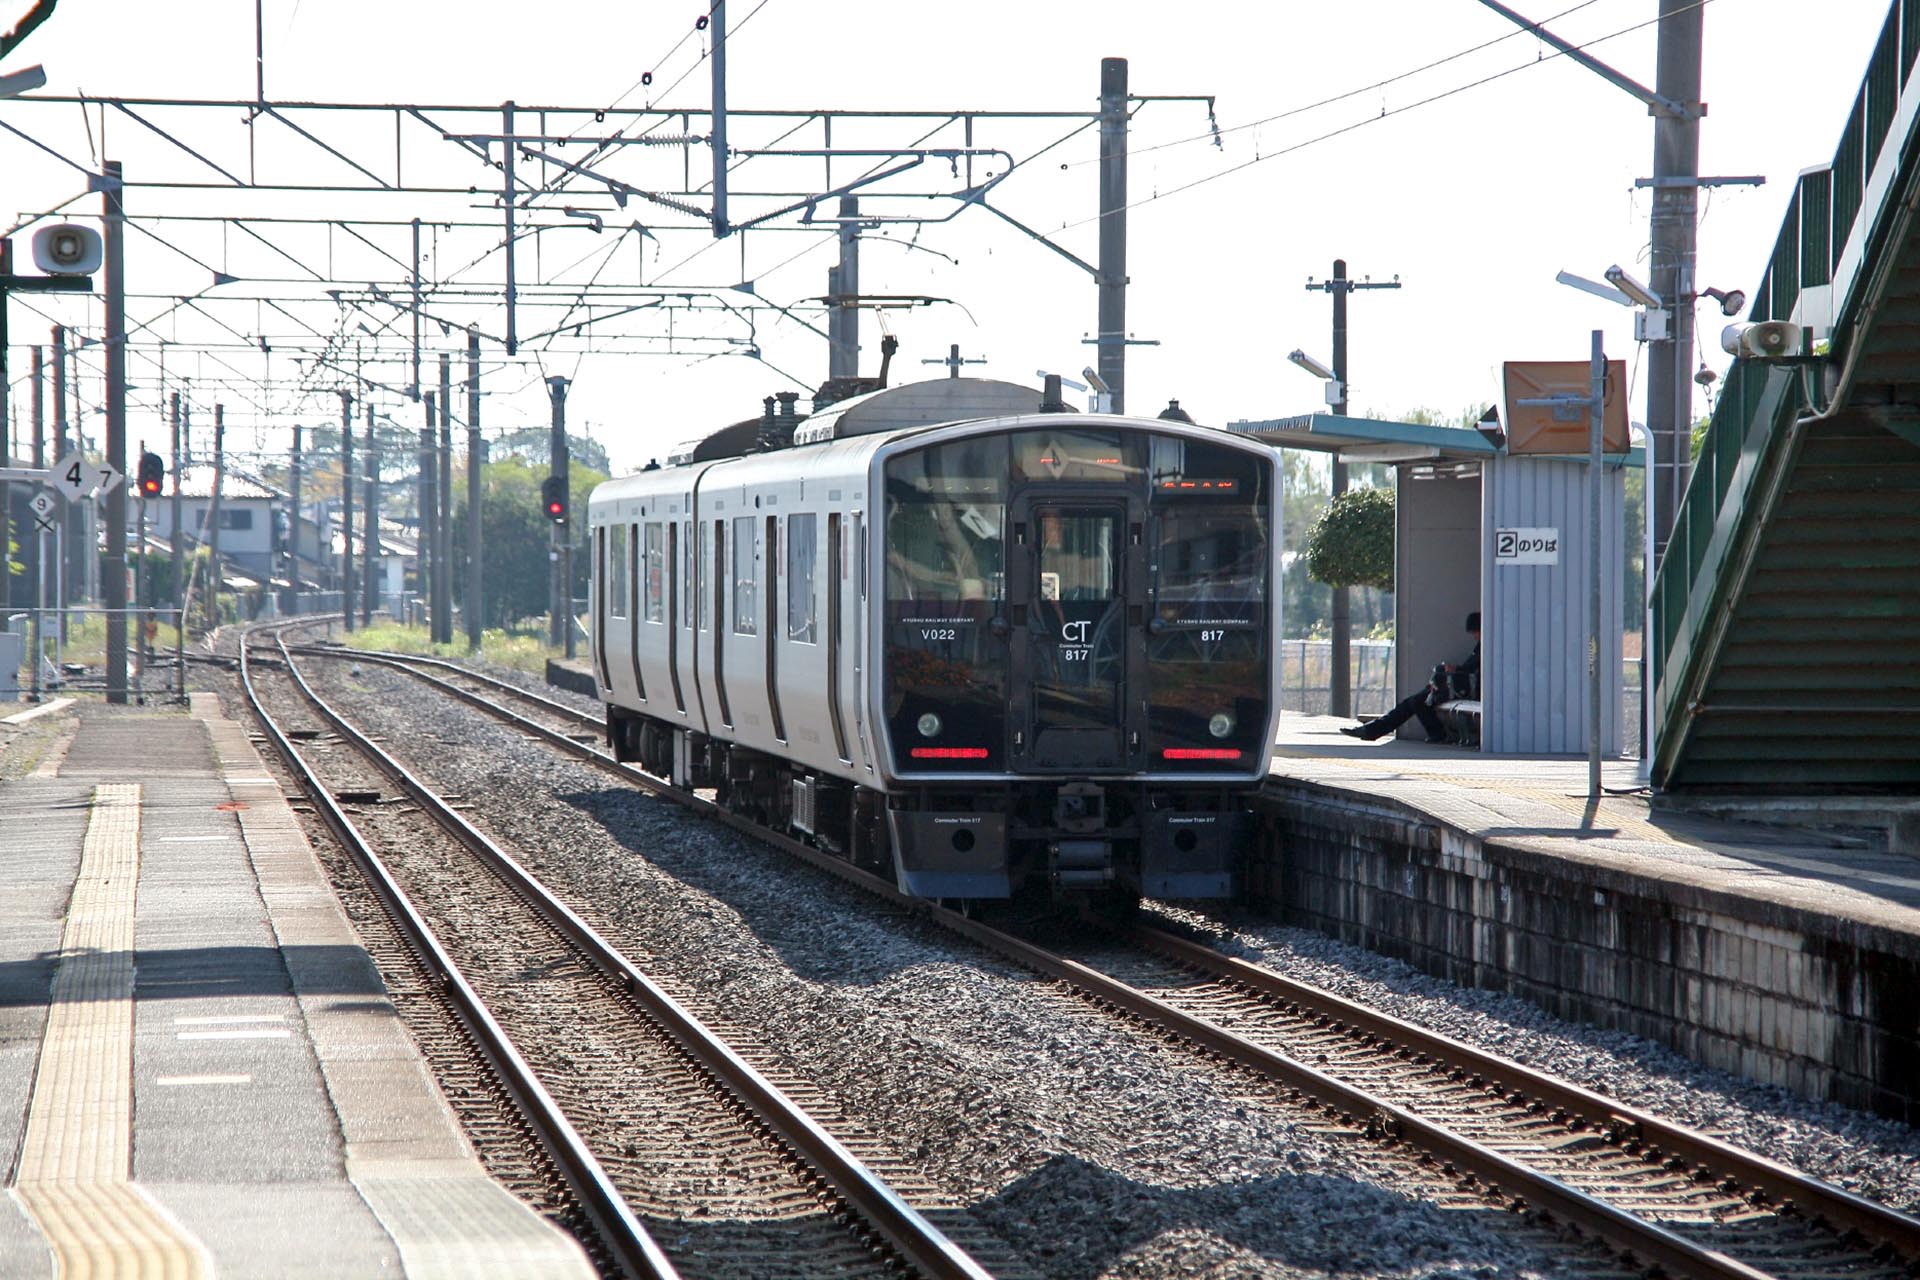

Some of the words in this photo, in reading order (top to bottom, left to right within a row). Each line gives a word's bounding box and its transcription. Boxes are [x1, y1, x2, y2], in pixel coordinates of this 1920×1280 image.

[66, 461, 82, 487] 4
[100, 470, 111, 487] 7
[37, 498, 46, 510] 9
[1500, 535, 1514, 552] 2
[921, 629, 955, 640] V022
[1062, 621, 1091, 642] CT
[1201, 630, 1224, 641] 817
[1065, 649, 1088, 660] 817
